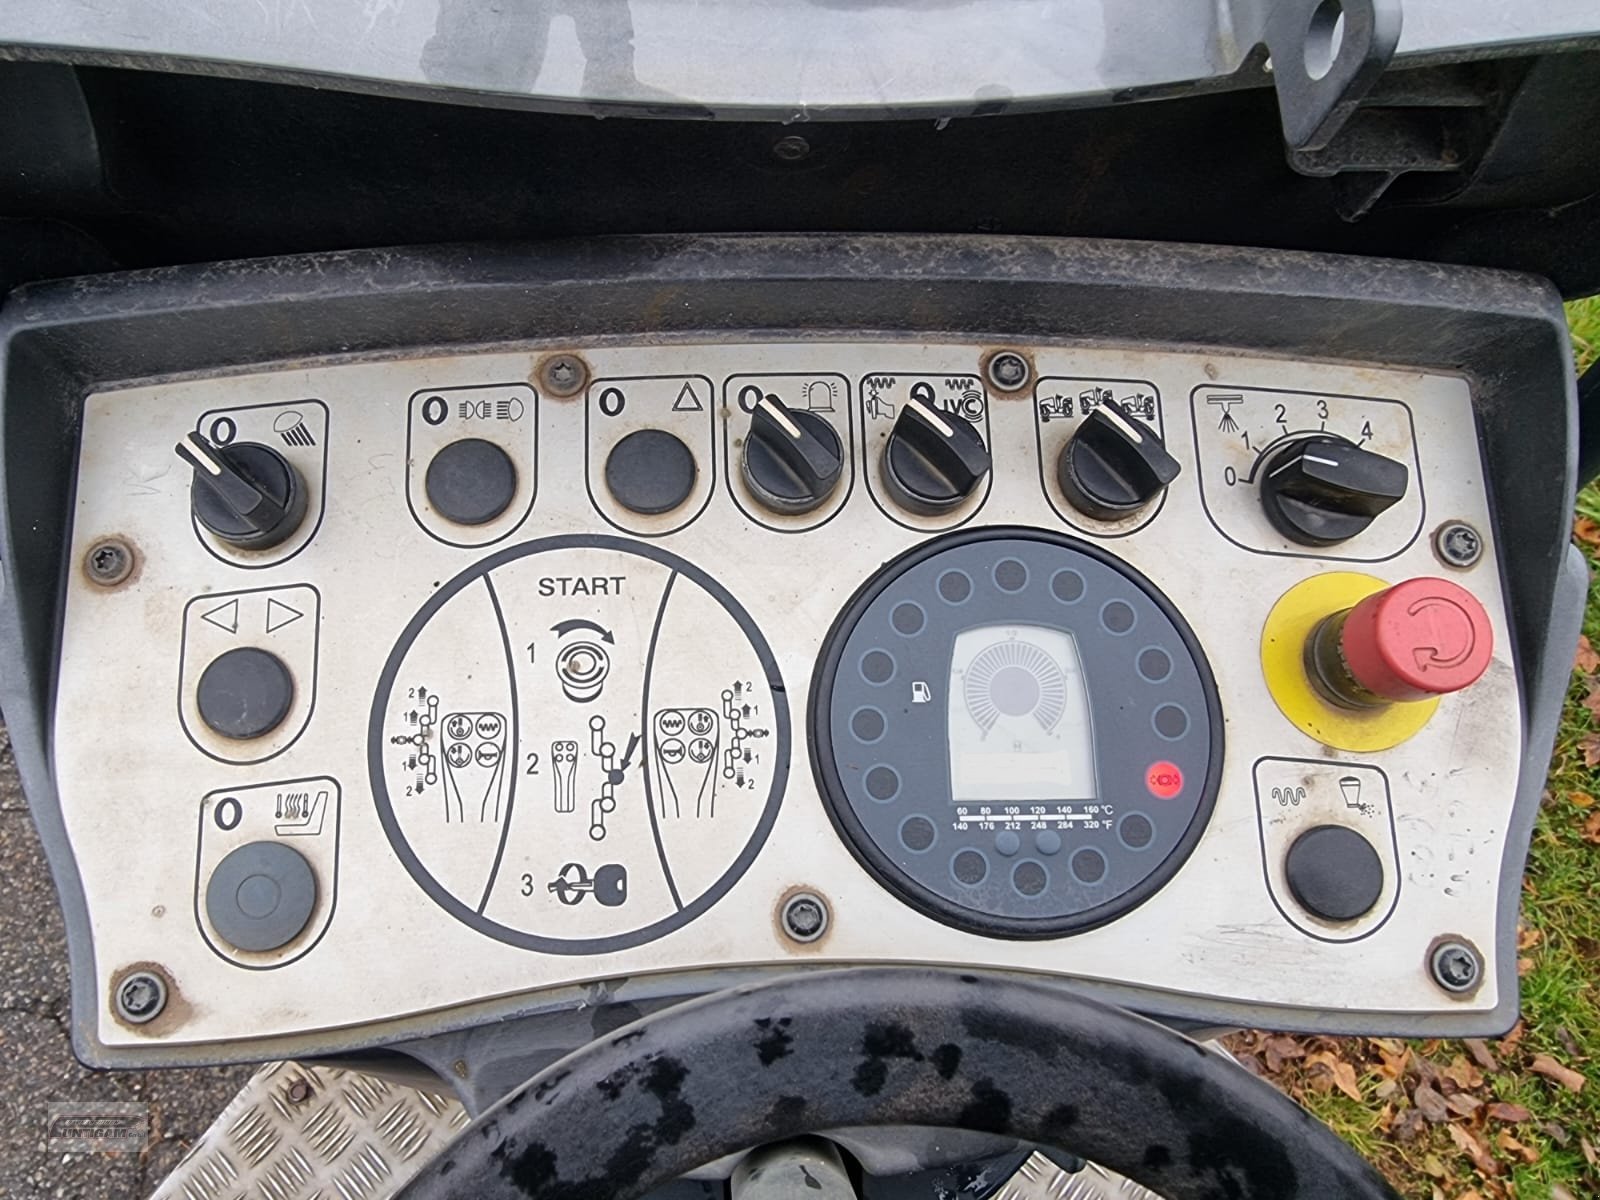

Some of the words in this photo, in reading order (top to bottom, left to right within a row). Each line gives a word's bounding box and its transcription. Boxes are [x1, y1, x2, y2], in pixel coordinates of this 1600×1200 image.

[599, 387, 626, 417] 0
[422, 396, 449, 425] 0
[1224, 466, 1237, 486] 0
[1240, 430, 1250, 450] 1
[1274, 404, 1288, 423] 2
[1316, 400, 1329, 419] 3
[1361, 420, 1374, 440] 4
[538, 577, 626, 597] START
[526, 642, 535, 664] 1
[408, 687, 415, 698] 2
[746, 681, 752, 692] 2
[753, 704, 758, 716] 1
[403, 711, 408, 722] 1
[526, 753, 539, 775] 2
[754, 753, 759, 765] 1
[402, 761, 407, 772] 1
[748, 778, 755, 790] 2
[406, 785, 413, 797] 2
[214, 797, 243, 831] 0
[957, 806, 968, 815] 60
[980, 806, 991, 815] 80
[1004, 806, 1020, 815] 100
[1030, 806, 1046, 814] 120
[1057, 805, 1072, 814] 140
[1083, 805, 1099, 814] 160
[952, 822, 968, 831] 140
[979, 822, 995, 831] 176
[1005, 822, 1021, 830] 212
[1031, 822, 1047, 830] 248
[1057, 821, 1073, 830] 284
[1084, 821, 1099, 829] 320
[520, 873, 534, 897] 3
